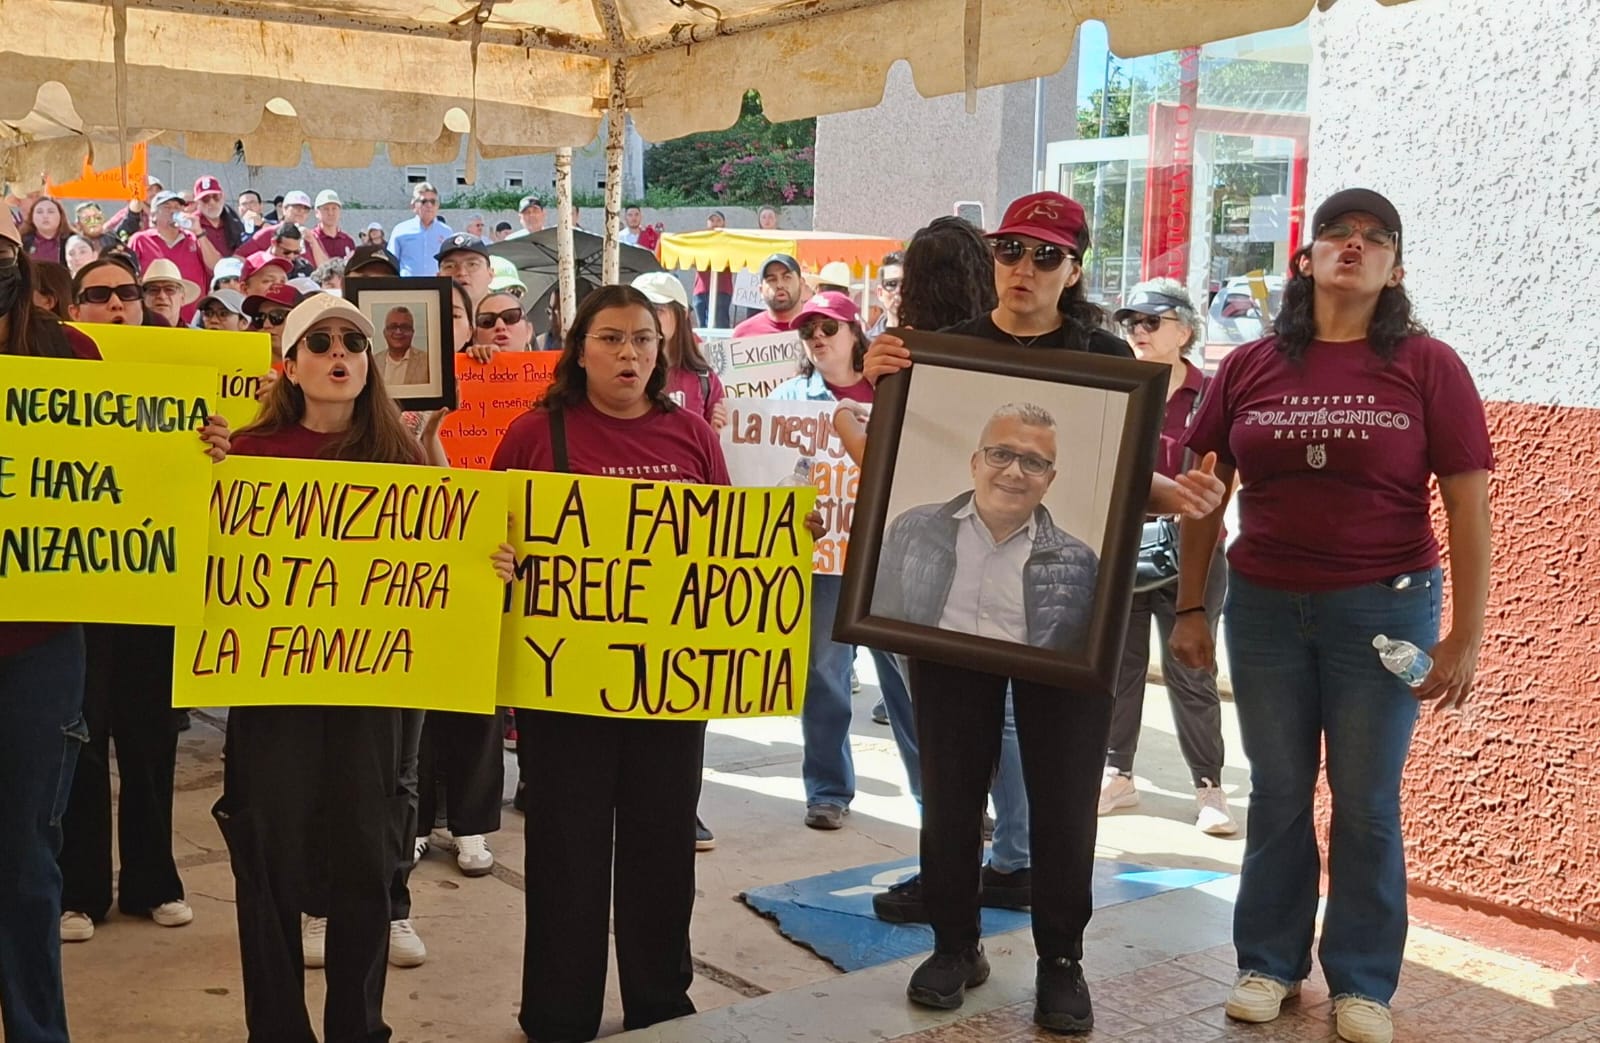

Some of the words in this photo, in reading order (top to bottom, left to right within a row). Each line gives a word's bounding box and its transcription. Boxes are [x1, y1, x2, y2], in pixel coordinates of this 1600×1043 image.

[489, 365, 519, 382] doctor
[724, 378, 793, 398] DEMN
[6, 387, 210, 432] NEGLIGENCIA
[1245, 407, 1410, 430] POLITÉCNICO
[1282, 395, 1375, 405] INSTITUTO
[458, 422, 488, 438] todos
[731, 408, 762, 445] La
[1274, 428, 1369, 440] NACIONAL
[30, 456, 124, 505] HAYA
[602, 464, 678, 475] INSTITUTO
[523, 479, 591, 548] LA
[625, 482, 799, 559] FAMILIA
[360, 558, 450, 609] PARA
[503, 554, 653, 624] MERECE
[670, 562, 805, 635] APOYO
[192, 628, 240, 677] LA
[260, 624, 414, 678] FAMILIA
[524, 635, 567, 698] Y
[599, 642, 794, 715] JUSTICIA
